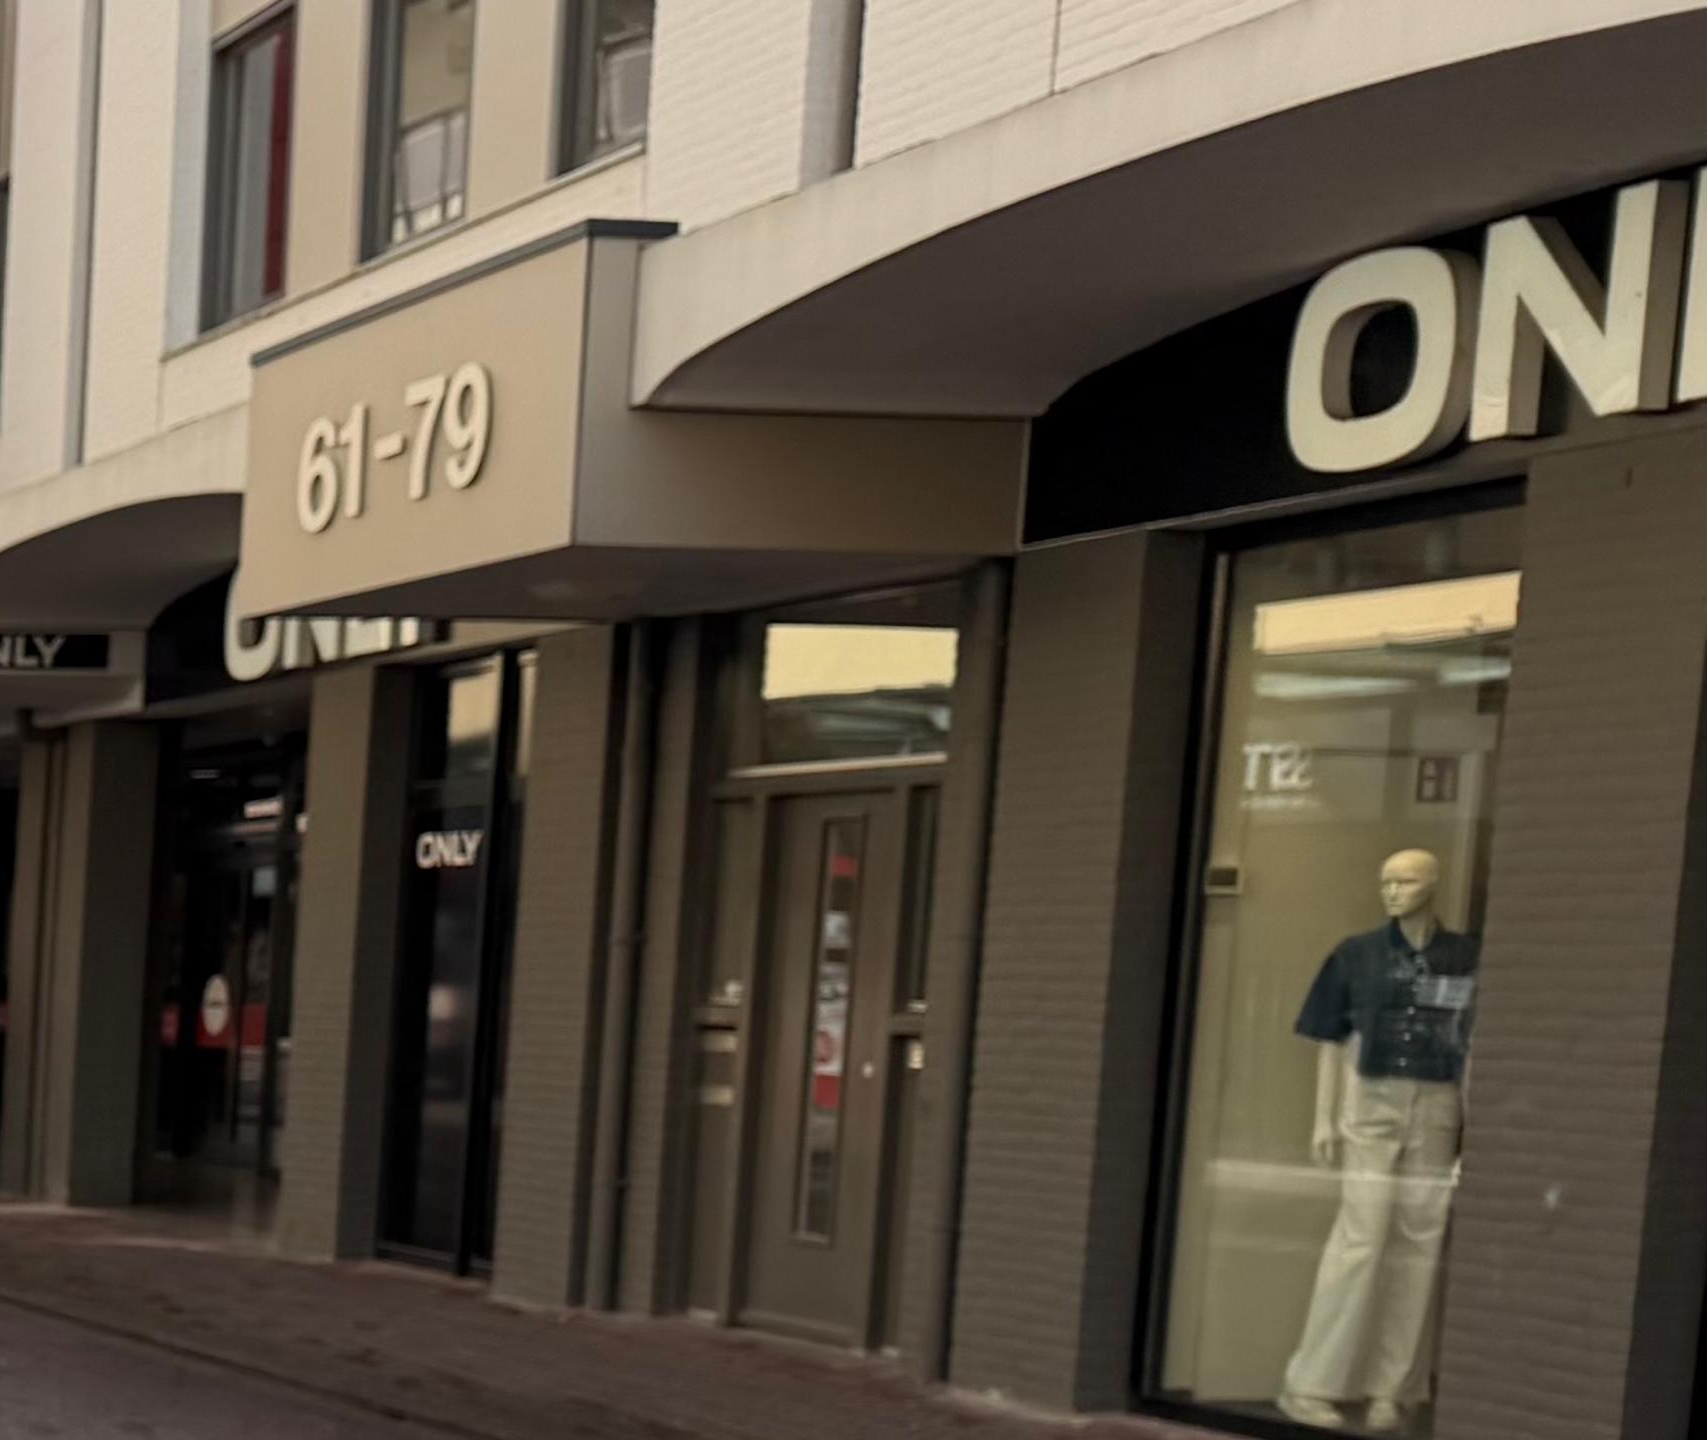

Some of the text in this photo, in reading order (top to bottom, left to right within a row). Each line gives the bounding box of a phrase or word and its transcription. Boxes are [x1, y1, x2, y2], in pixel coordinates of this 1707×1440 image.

[1287, 164, 1707, 474] ON
[296, 361, 490, 534] 61-79
[416, 829, 484, 869] ONLY
